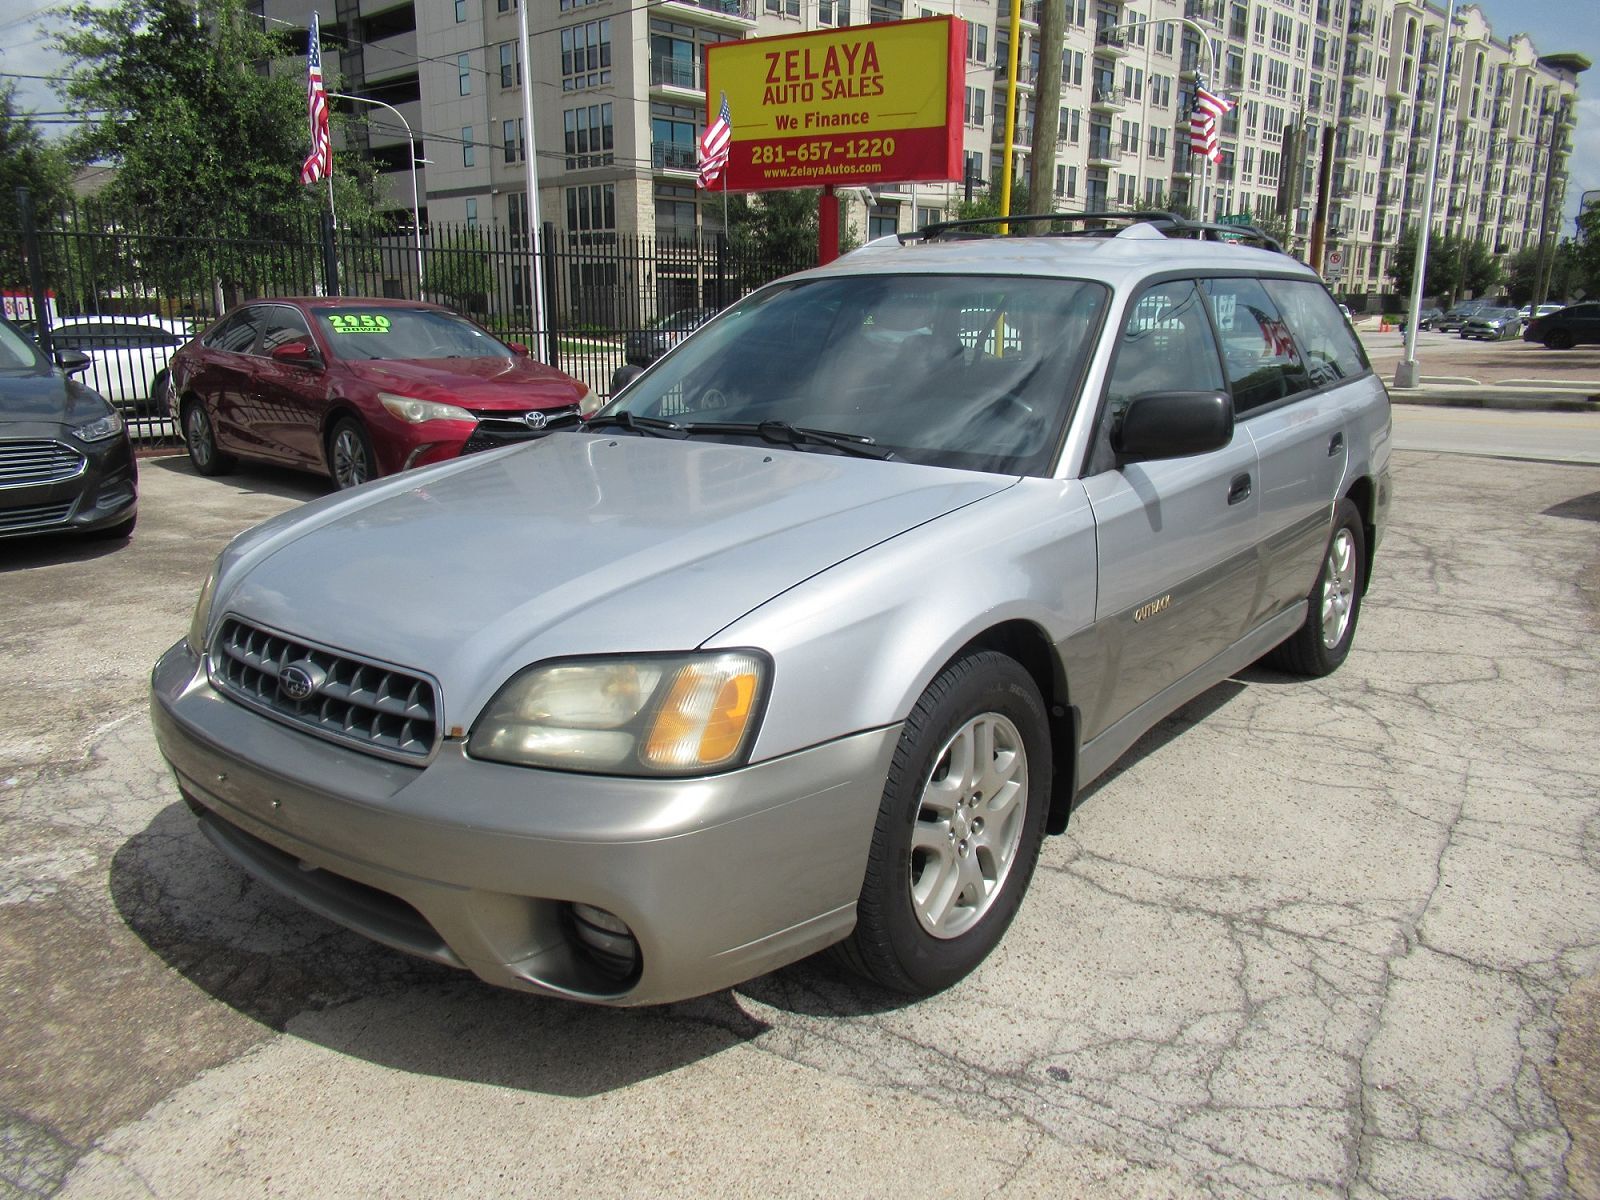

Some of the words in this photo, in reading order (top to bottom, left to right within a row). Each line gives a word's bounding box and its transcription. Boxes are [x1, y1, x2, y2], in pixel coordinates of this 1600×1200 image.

[765, 41, 881, 84] ZELAYA
[762, 82, 814, 106] AUTO
[821, 75, 884, 101] SALES
[775, 114, 799, 131] We
[804, 111, 870, 129] Finance
[751, 137, 896, 165] 281-657-1220
[763, 163, 882, 179] www.ZelayaAutos.com
[328, 314, 391, 328] 2950
